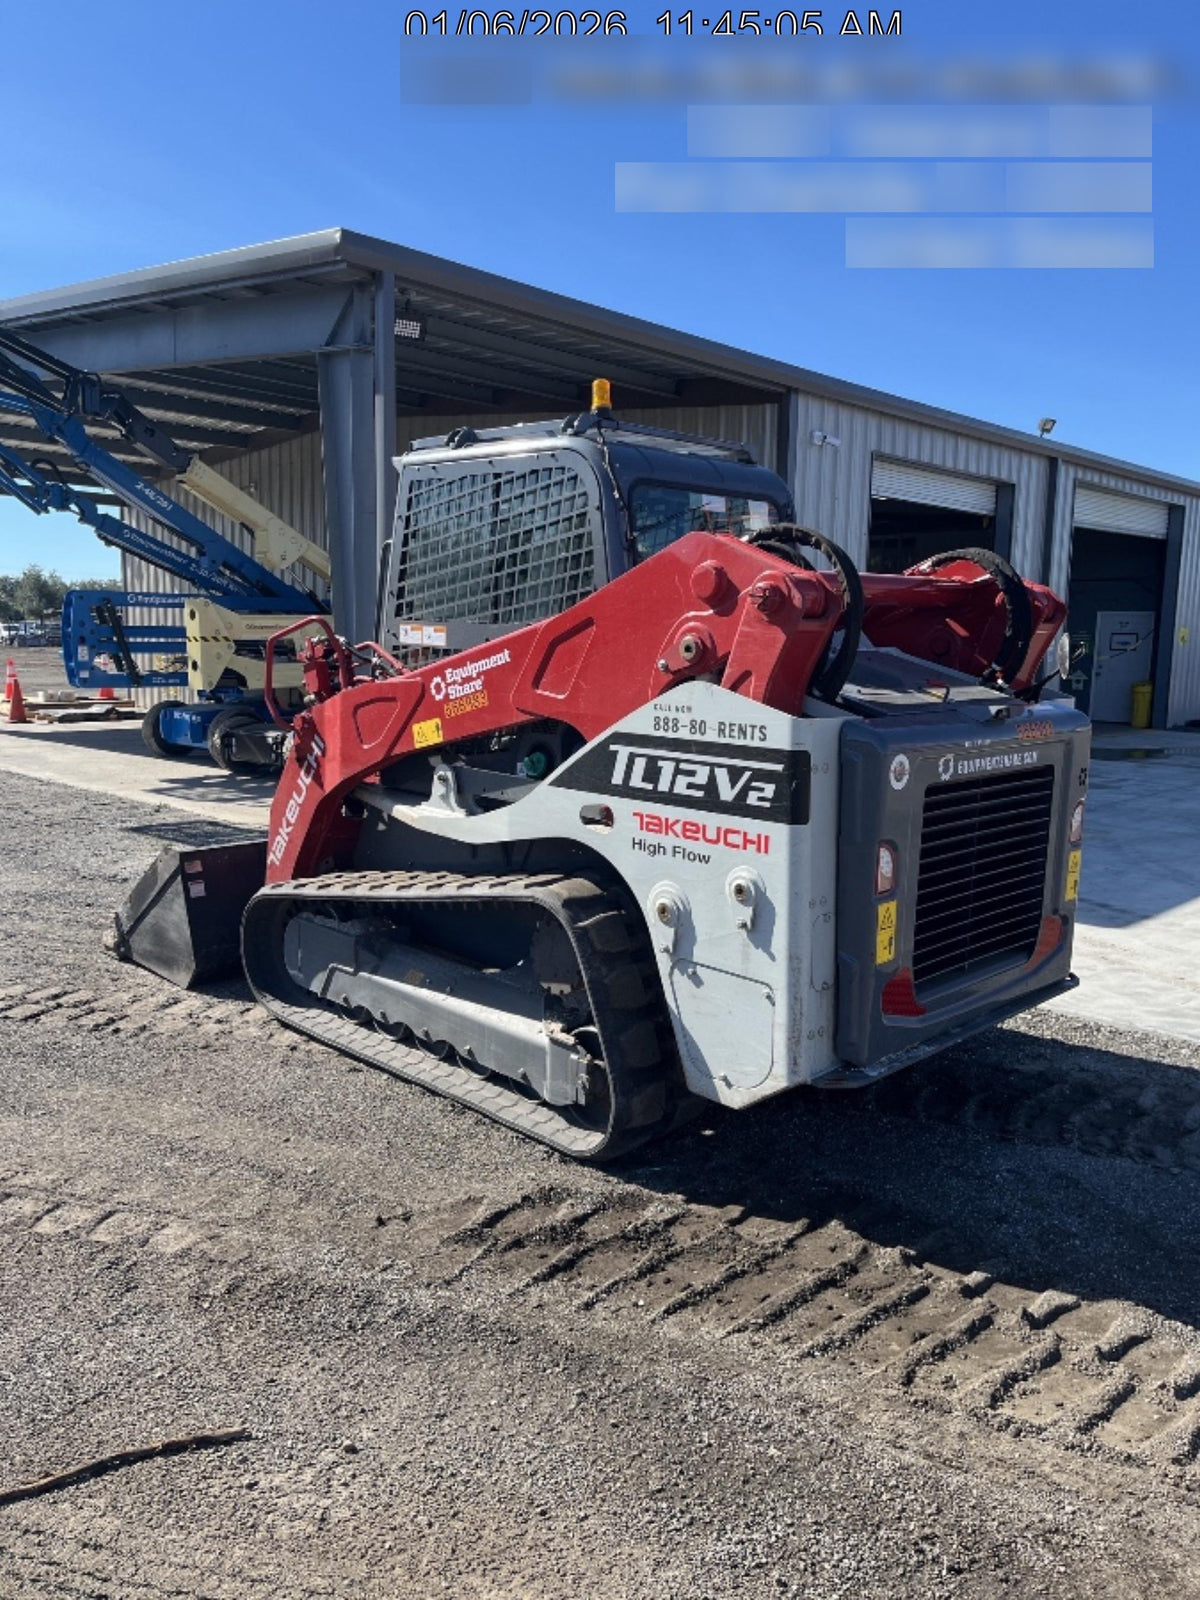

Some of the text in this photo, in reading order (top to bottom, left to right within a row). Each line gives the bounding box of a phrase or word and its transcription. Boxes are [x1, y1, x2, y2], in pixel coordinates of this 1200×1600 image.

[445, 648, 511, 683] Equipment
[447, 675, 484, 699] Share
[632, 811, 771, 855] TAKEUCHI
[632, 836, 711, 865] High Flow
